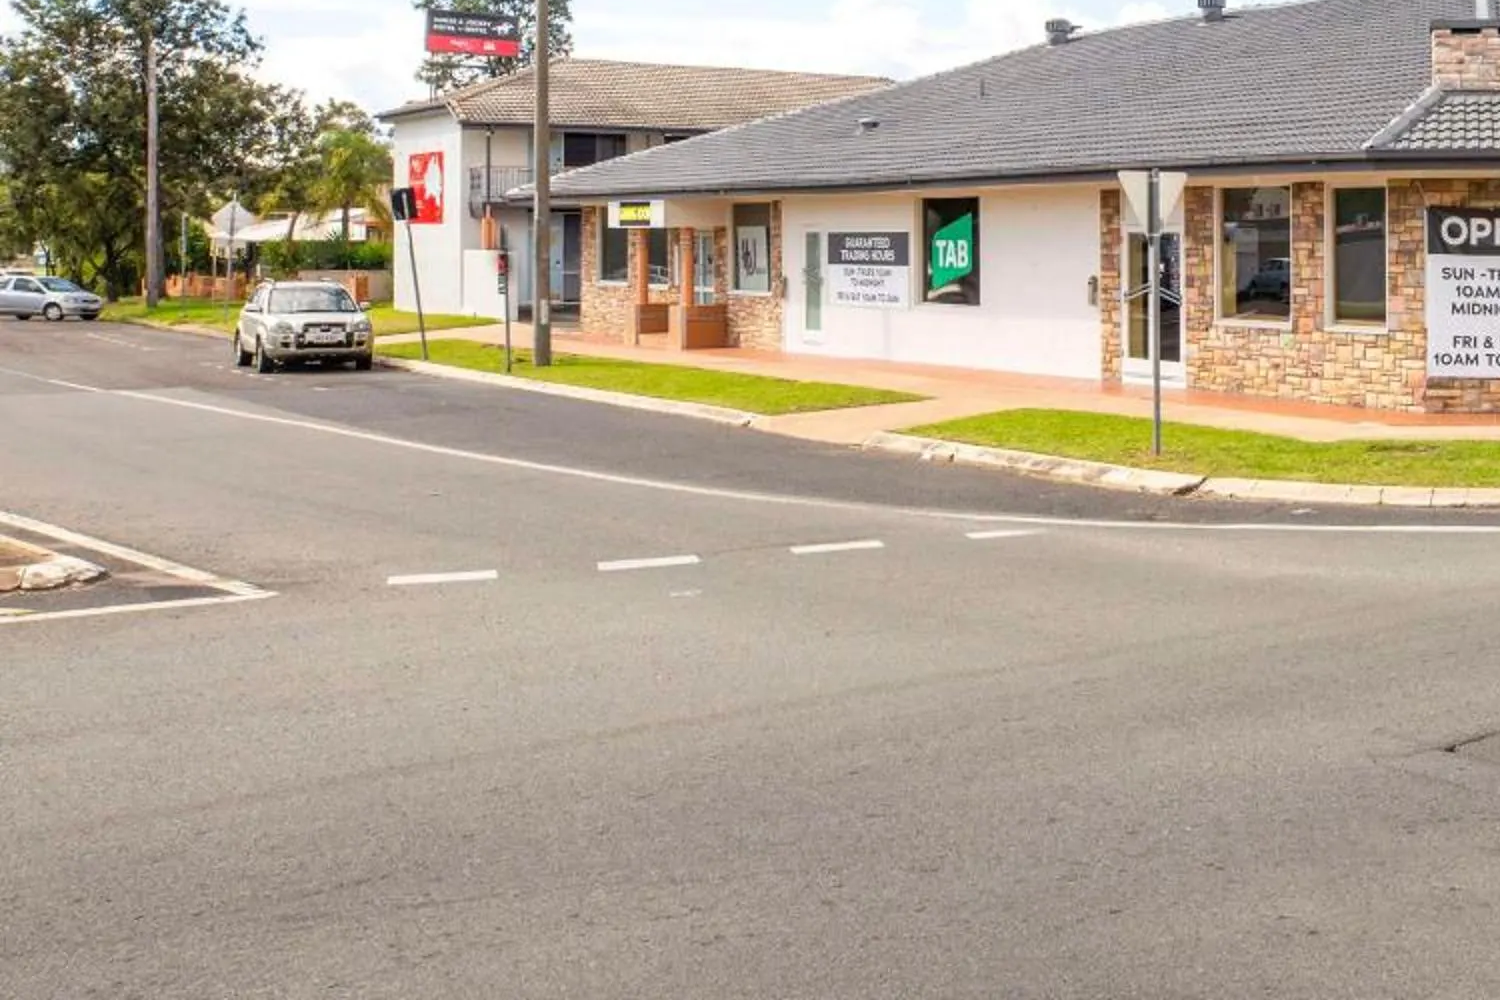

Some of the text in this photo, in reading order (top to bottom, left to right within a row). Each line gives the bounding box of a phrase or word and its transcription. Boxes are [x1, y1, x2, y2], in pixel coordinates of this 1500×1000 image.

[935, 239, 969, 269] TAB
[1441, 267, 1475, 281] SUN
[1455, 285, 1500, 299] 10AM
[1453, 336, 1478, 349] FRI
[1483, 336, 1494, 349] &
[1434, 353, 1480, 367] 10AM
